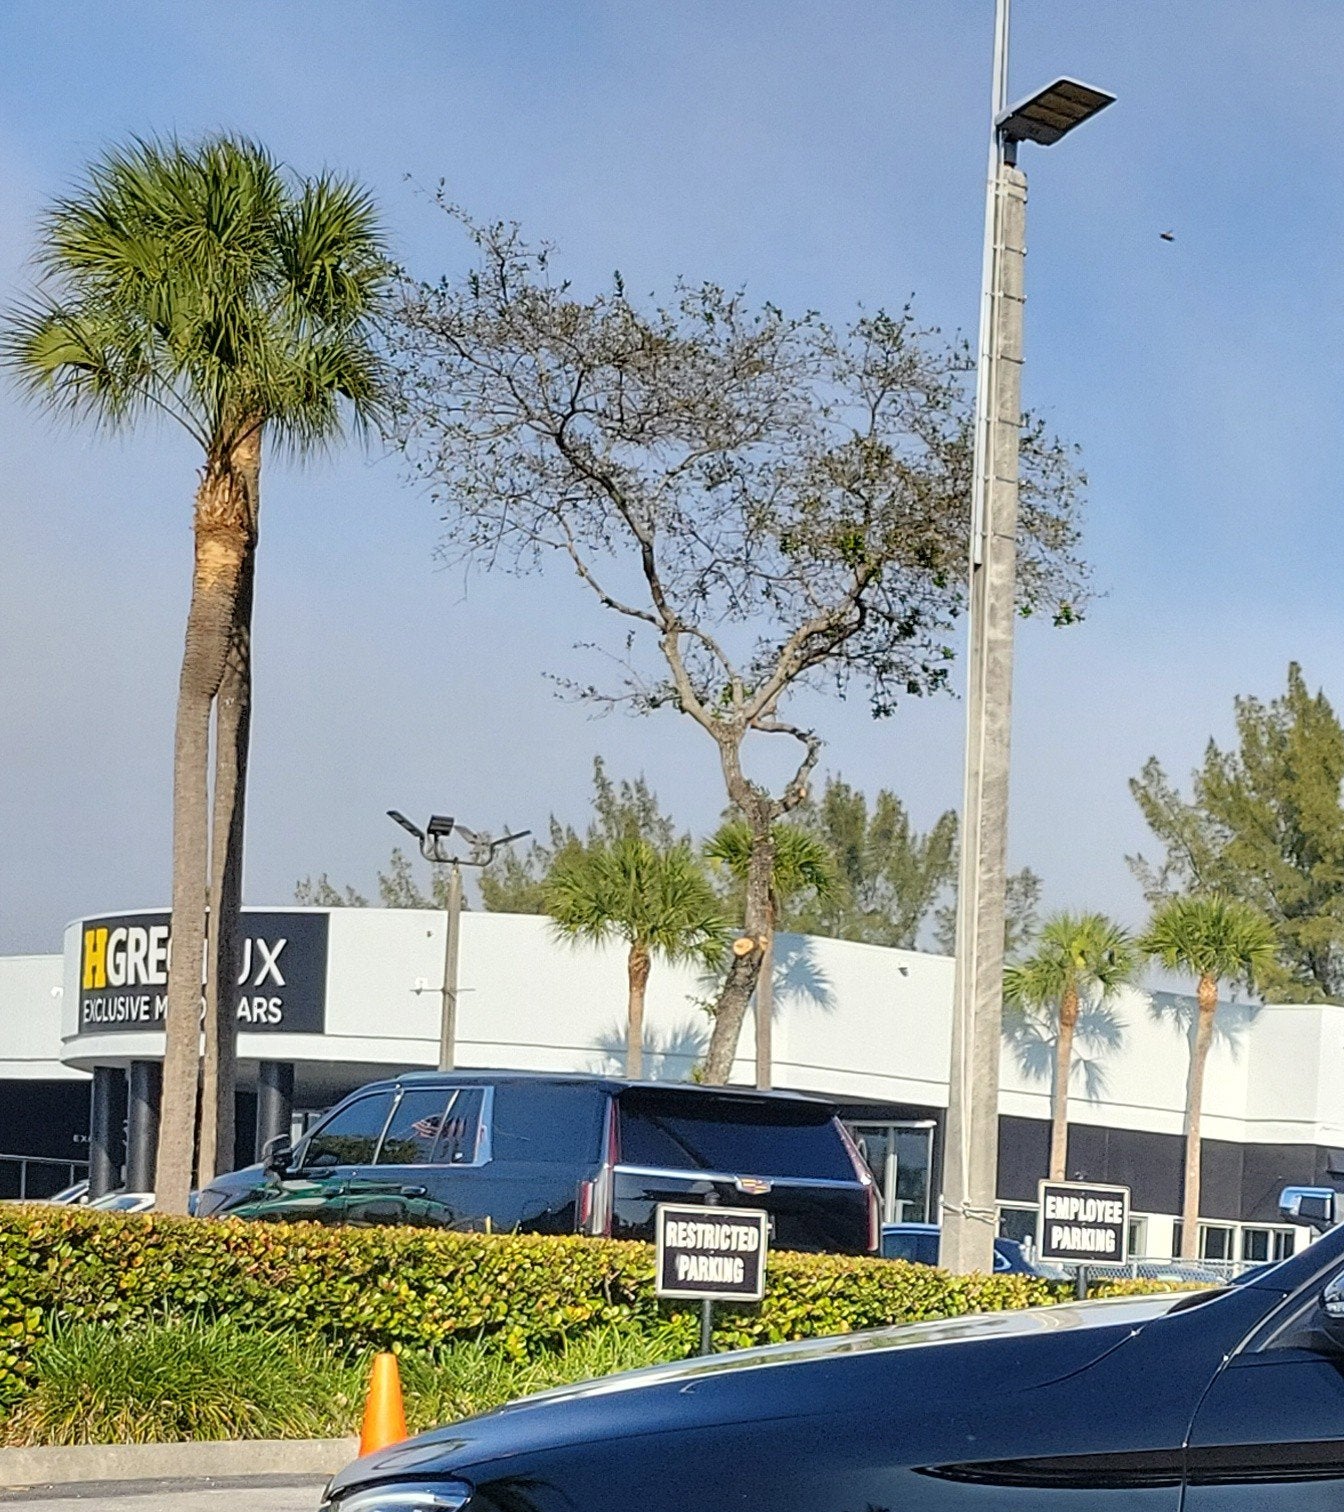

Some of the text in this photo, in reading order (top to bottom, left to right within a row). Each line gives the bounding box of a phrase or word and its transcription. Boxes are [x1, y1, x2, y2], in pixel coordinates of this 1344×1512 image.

[84, 995, 150, 1023] EXCLUSIVE
[237, 996, 283, 1024] ARS
[1045, 1195, 1123, 1224] EMPLOYEE
[665, 1220, 760, 1252] RESTRICTED
[1051, 1225, 1116, 1253] PARKING
[677, 1254, 745, 1284] PARKING
